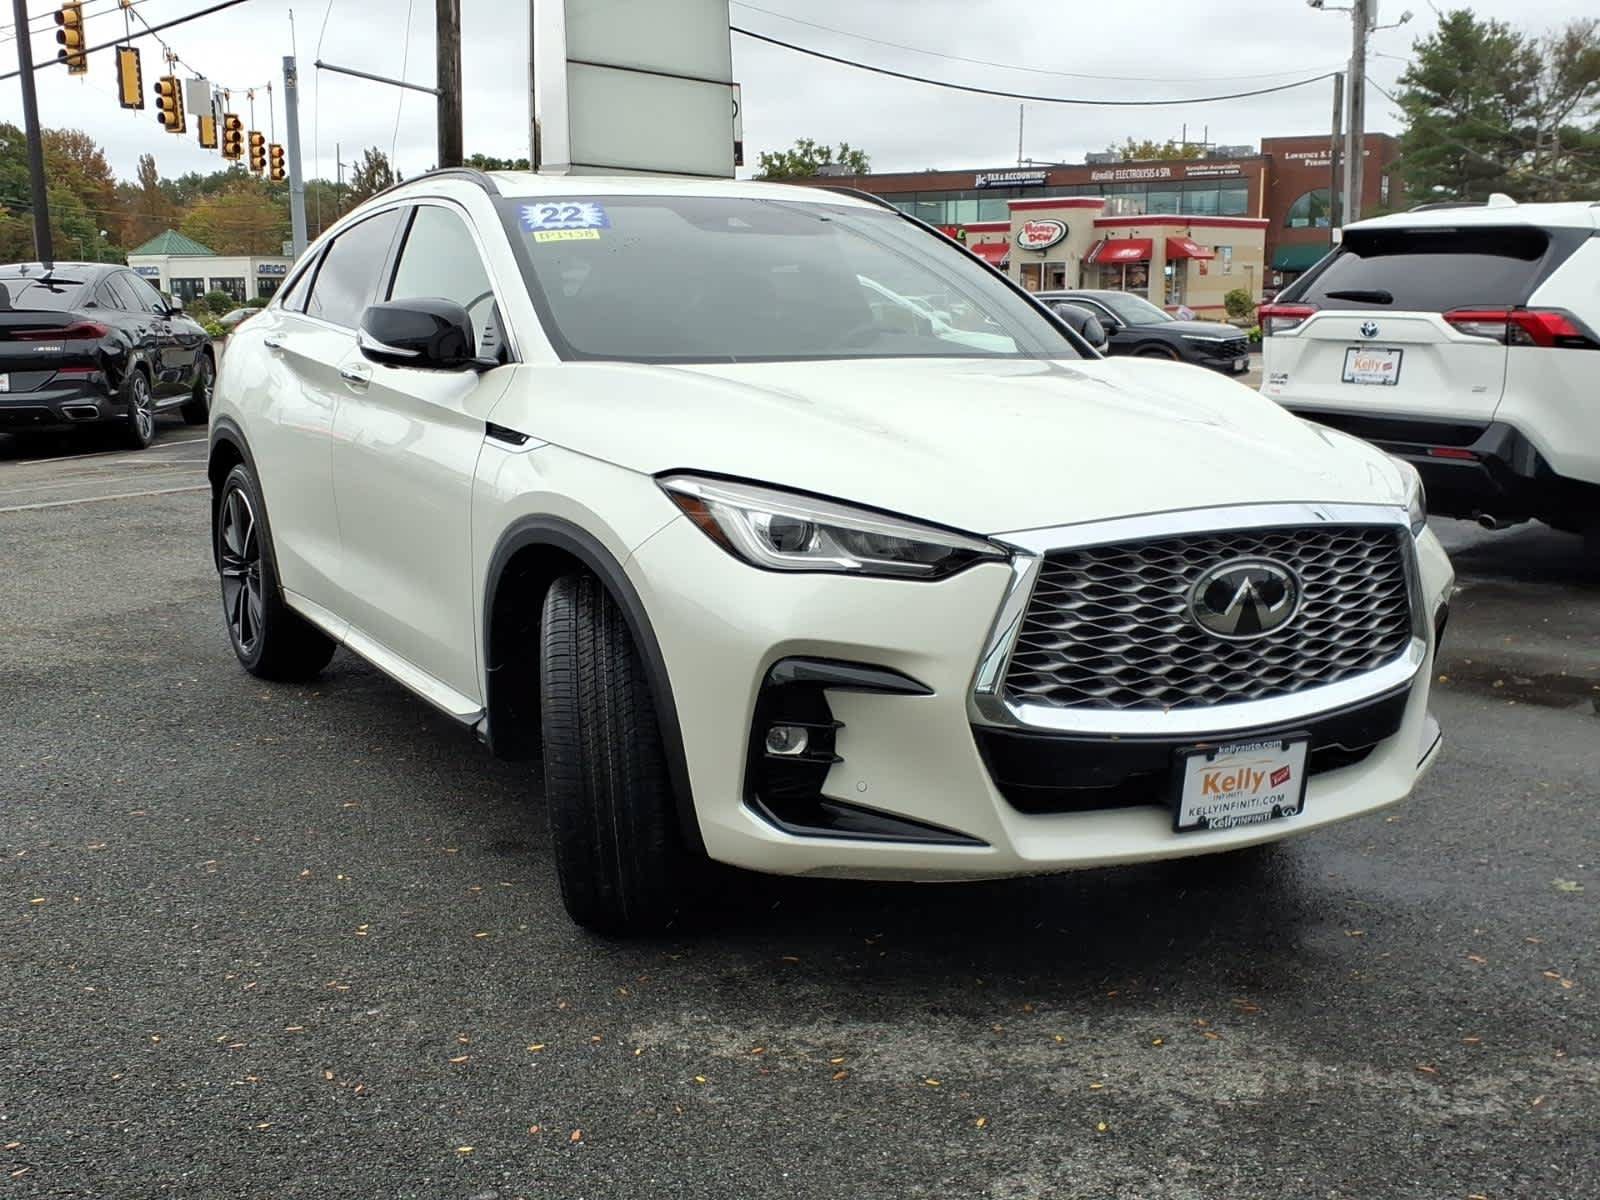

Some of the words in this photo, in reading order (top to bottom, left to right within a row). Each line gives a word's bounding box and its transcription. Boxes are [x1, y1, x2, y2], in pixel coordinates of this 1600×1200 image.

[1115, 167, 1154, 179] ELECTROLYSIS
[540, 206, 583, 223] 22
[258, 264, 286, 274] GEICO
[1354, 359, 1382, 372] Kelly
[1218, 740, 1282, 754] kellyauto.com
[1202, 767, 1266, 795] Kelly
[1188, 793, 1285, 816] KELLYINFINITI.COM
